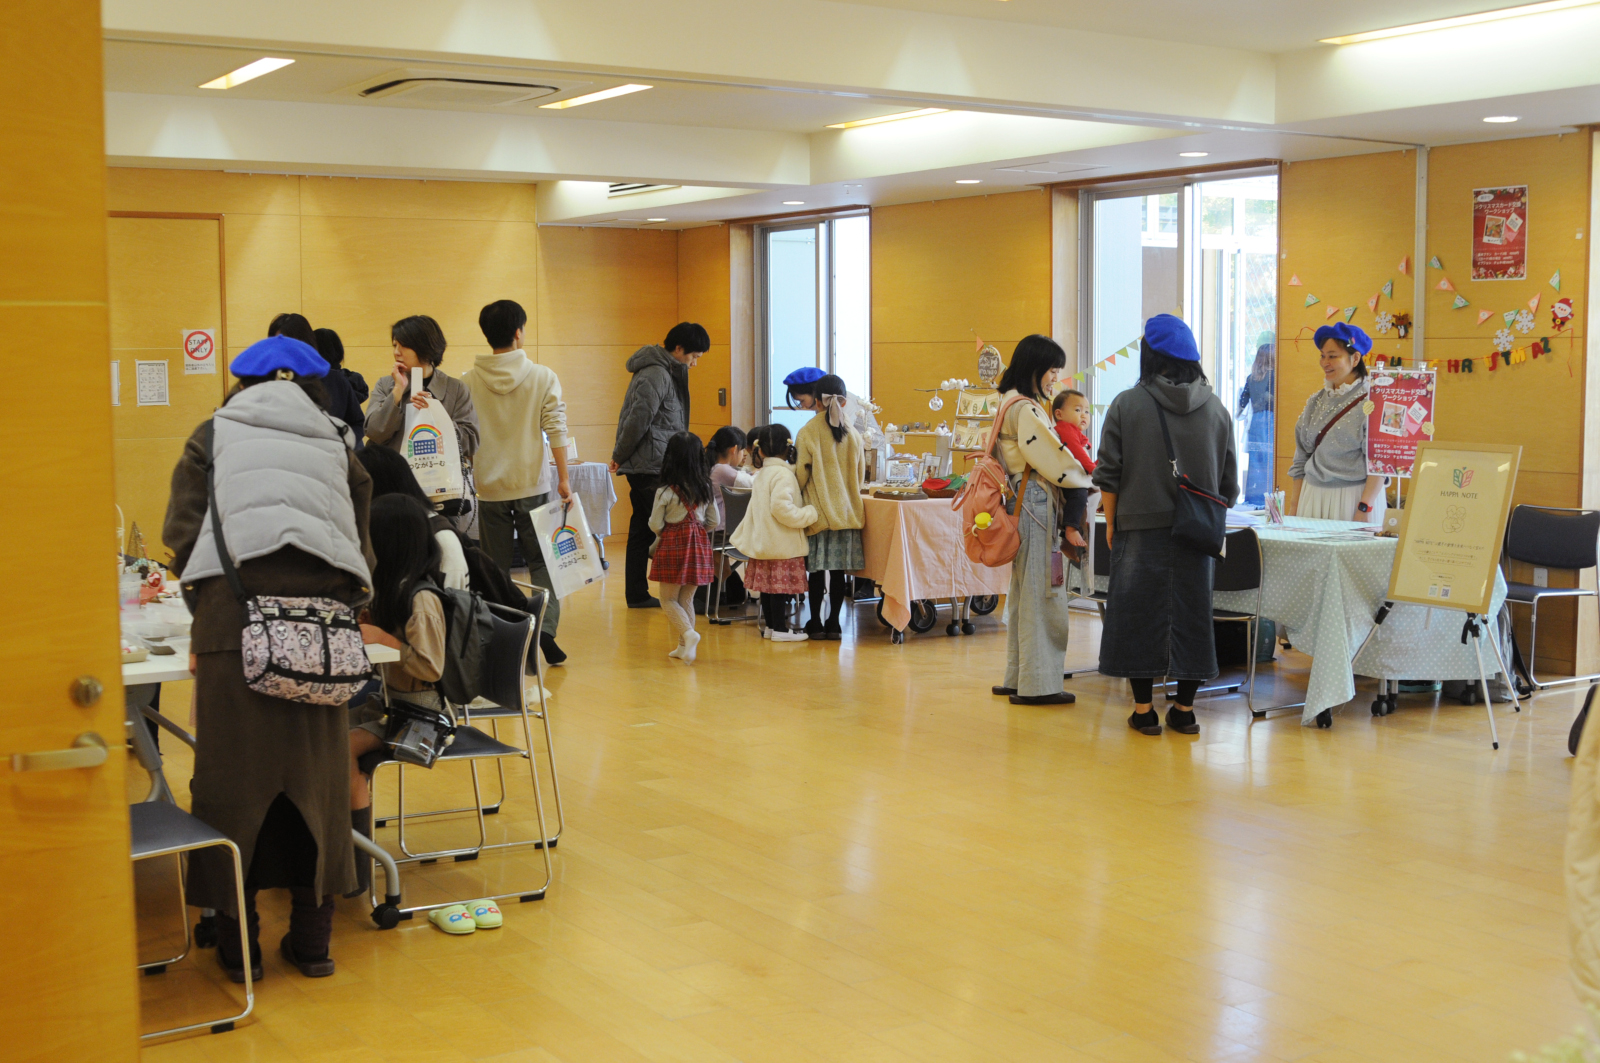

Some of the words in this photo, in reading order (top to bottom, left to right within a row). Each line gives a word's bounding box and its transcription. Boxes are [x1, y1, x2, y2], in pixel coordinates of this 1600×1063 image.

[409, 460, 446, 469] つながるーむ
[1440, 490, 1459, 498] HAPPA
[558, 554, 588, 570] つながるーむ
